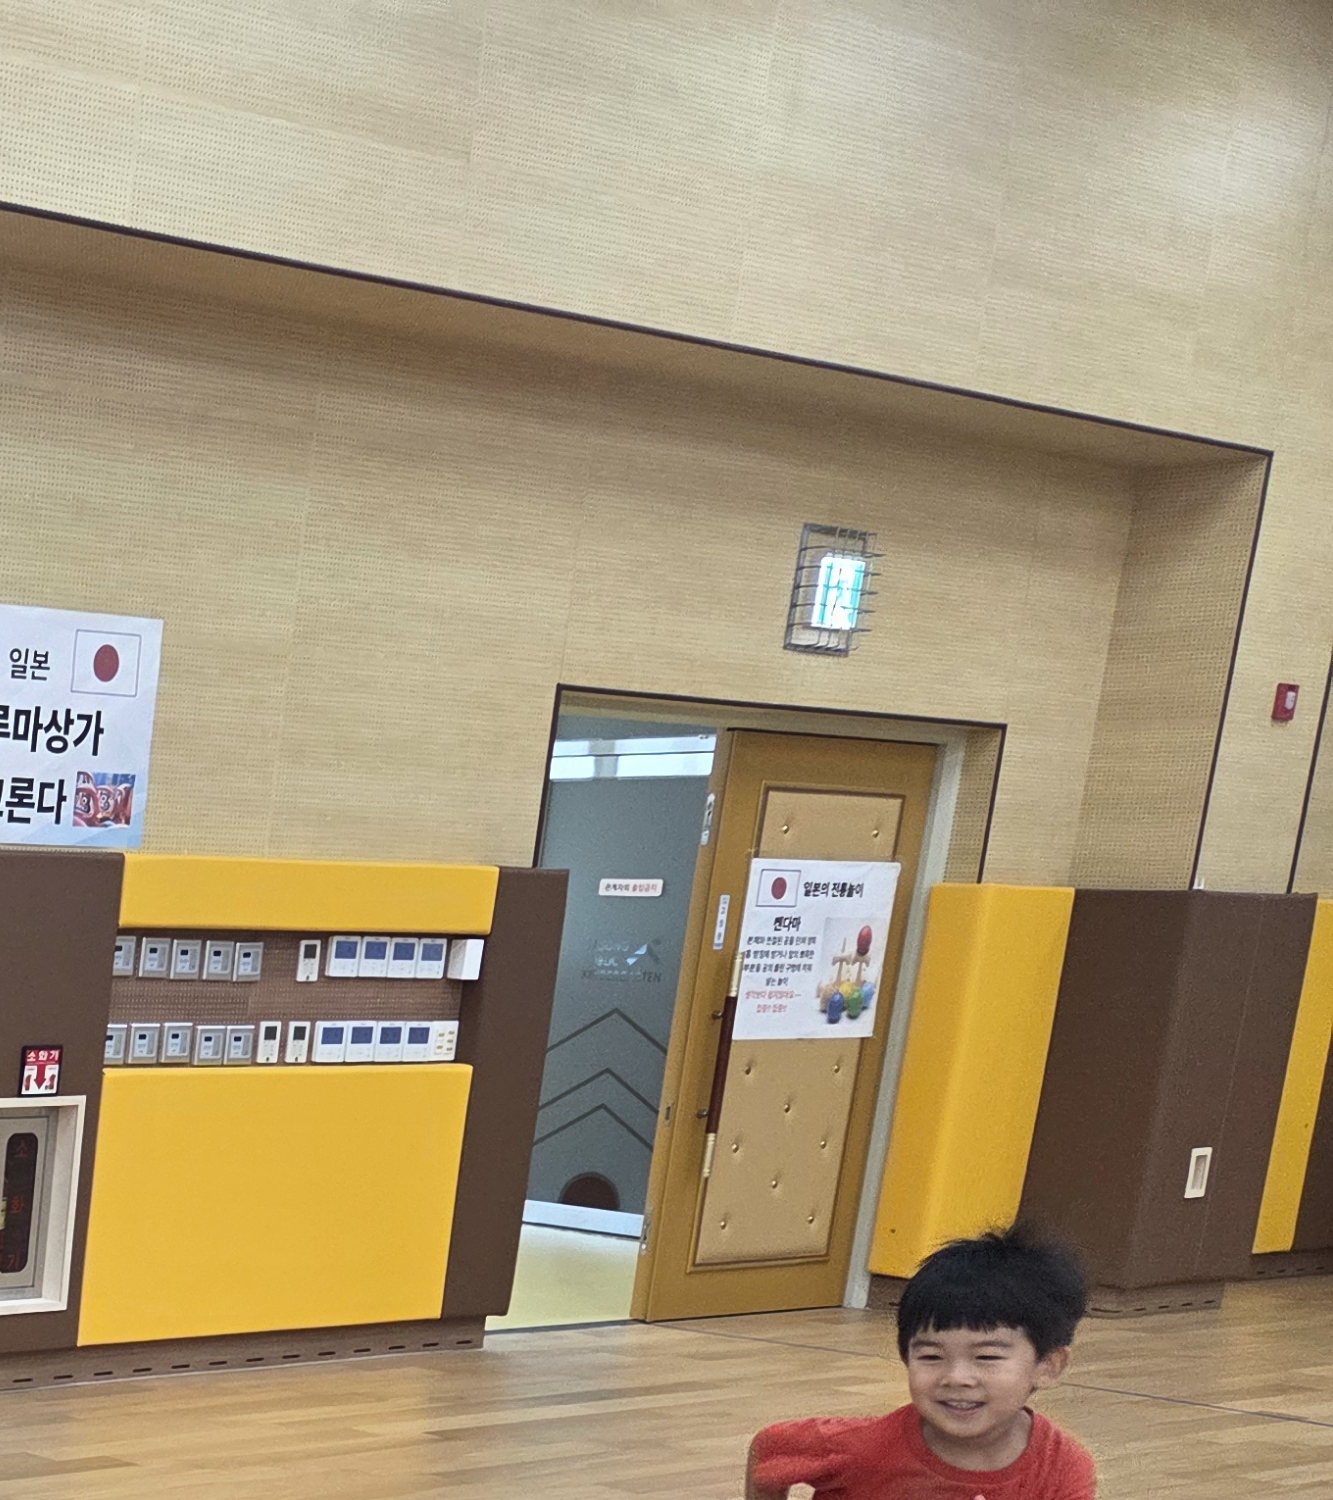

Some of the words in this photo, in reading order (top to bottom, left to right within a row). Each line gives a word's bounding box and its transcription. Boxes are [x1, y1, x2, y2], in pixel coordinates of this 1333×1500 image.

[9, 648, 50, 681] 일본
[803, 881, 830, 898] 일본의
[831, 881, 864, 898] 전통놀이
[26, 1049, 60, 1062] 소화기
